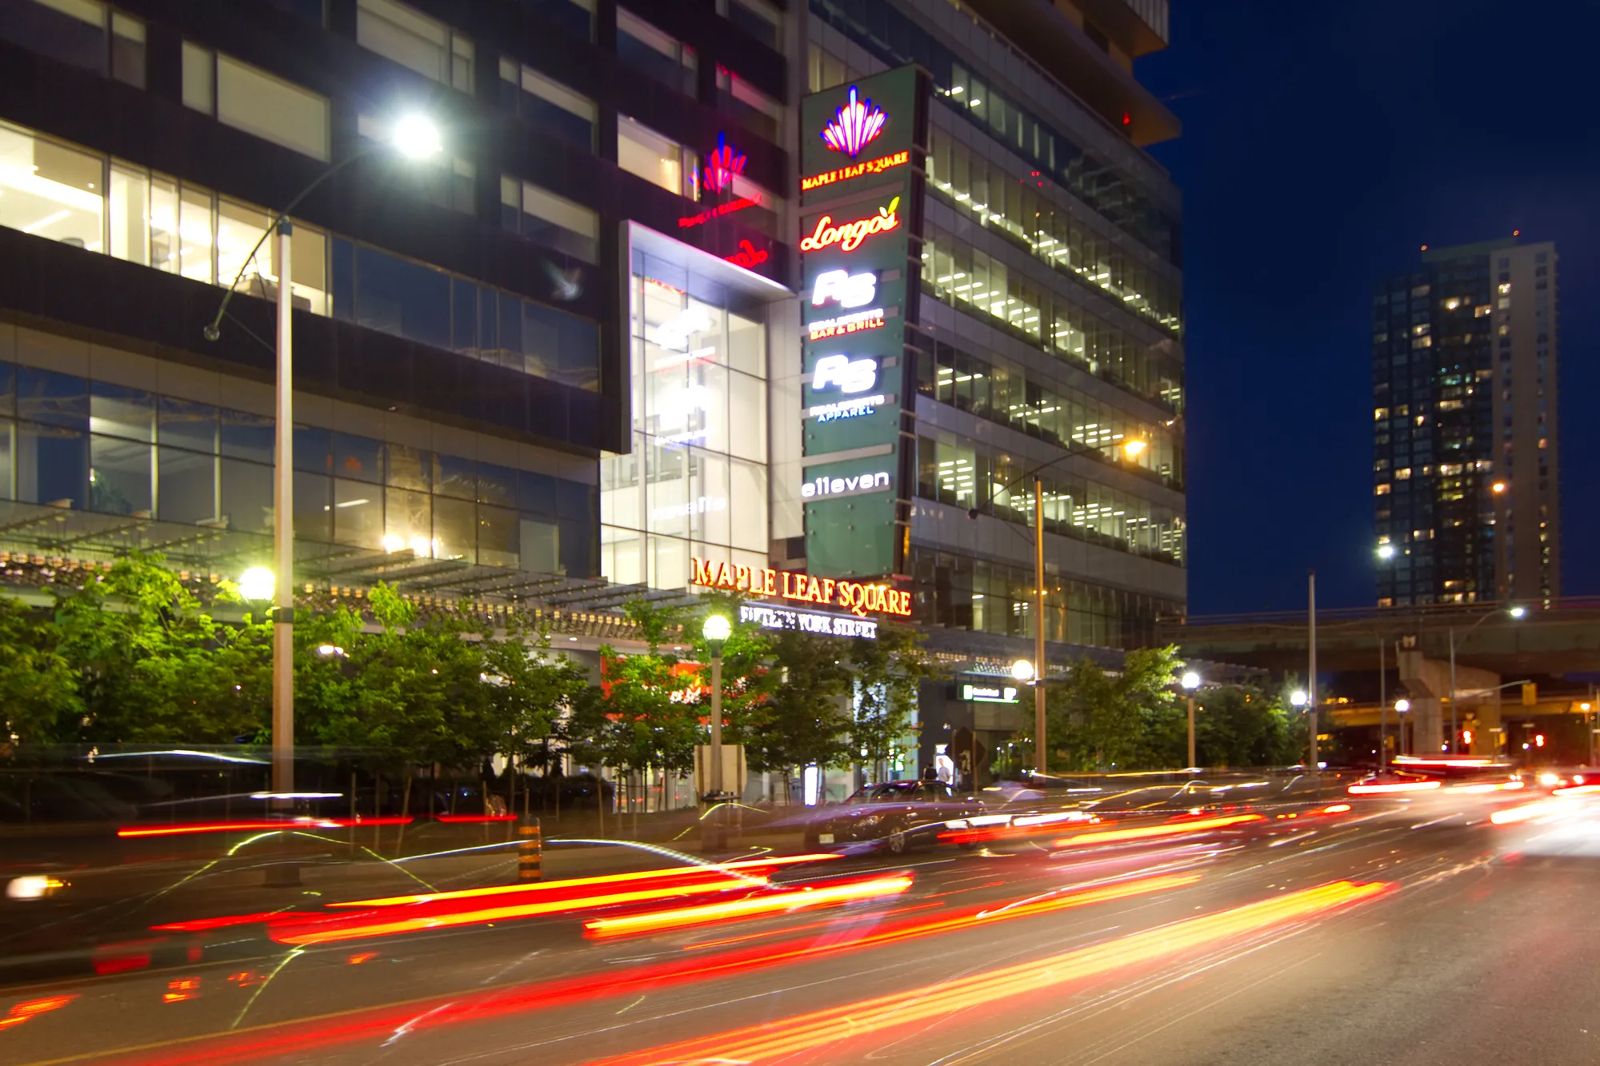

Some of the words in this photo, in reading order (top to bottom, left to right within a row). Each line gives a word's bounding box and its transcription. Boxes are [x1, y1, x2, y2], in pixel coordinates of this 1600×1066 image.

[802, 171, 838, 190] MAPLE
[866, 151, 909, 173] SQUARE
[847, 318, 884, 333] GRILL
[818, 406, 874, 422] APPAREL
[692, 556, 777, 596] MAPLE
[782, 571, 835, 604] LEAF
[839, 581, 911, 617] SQUARE
